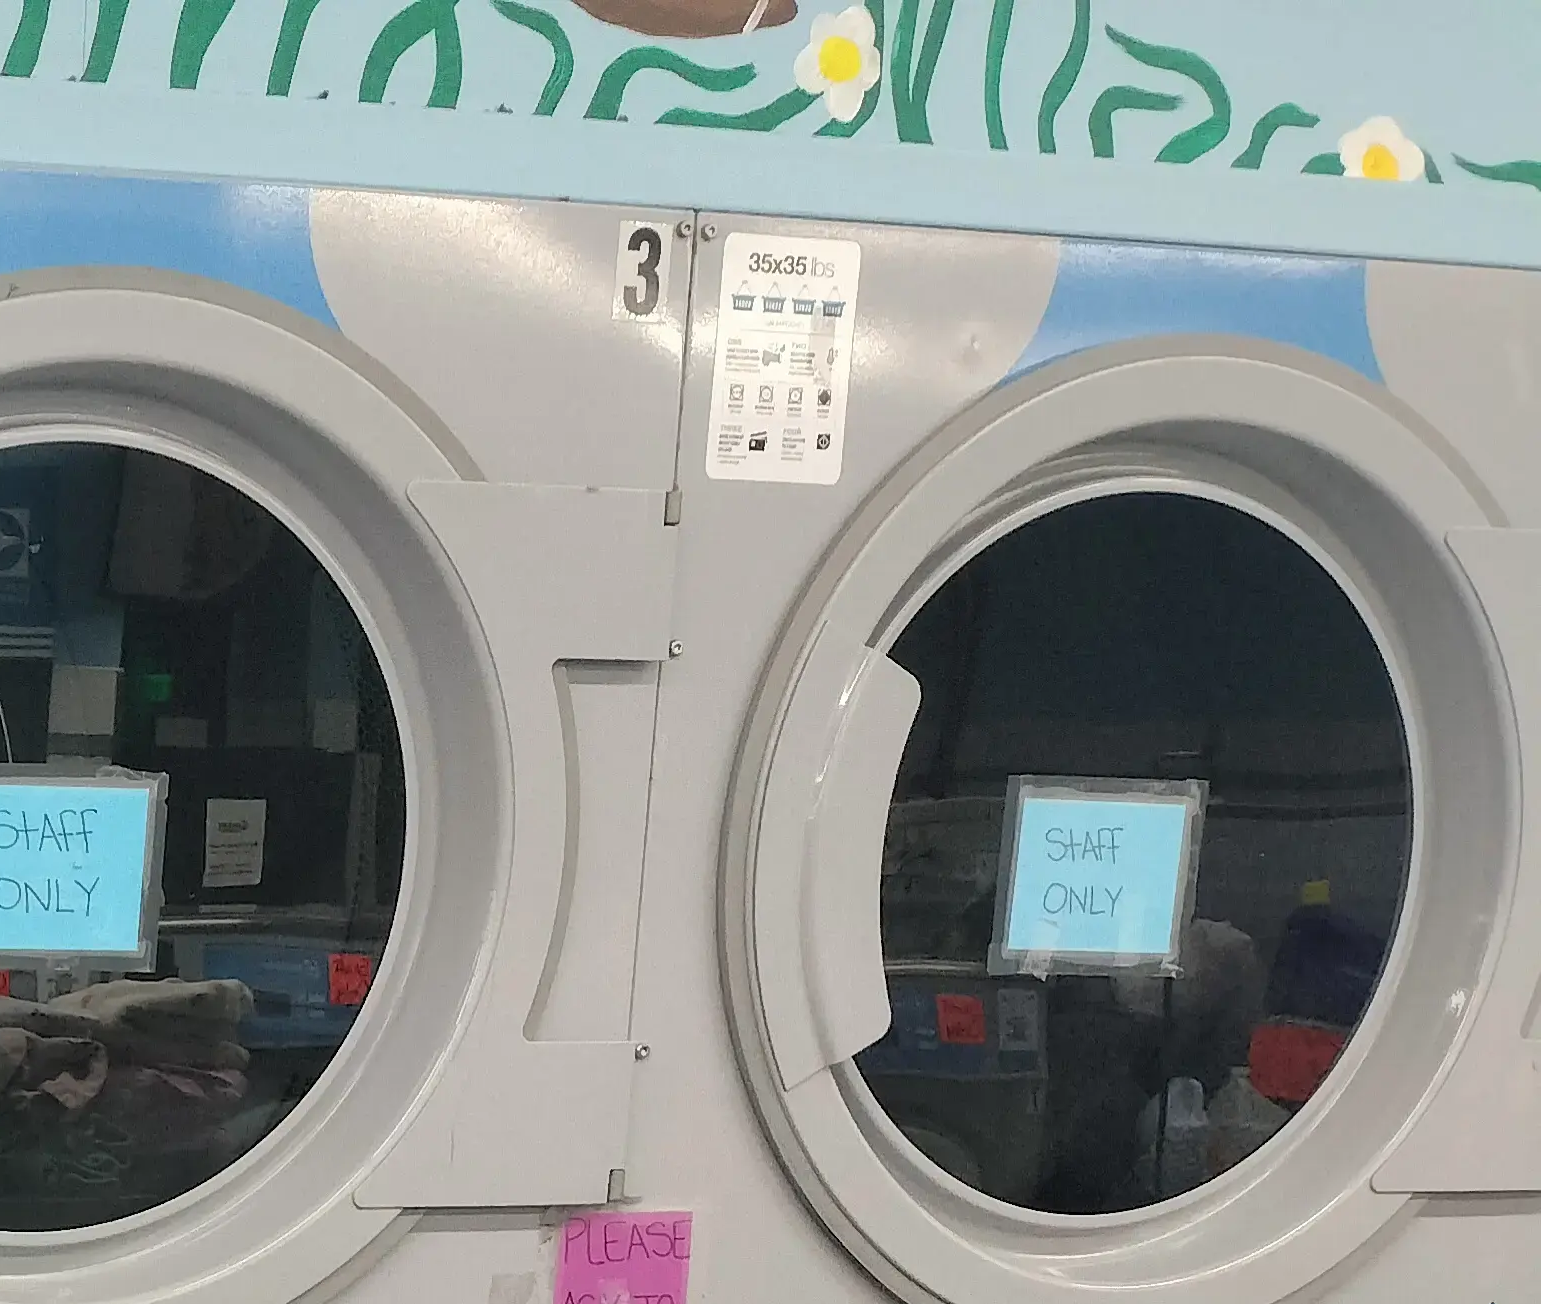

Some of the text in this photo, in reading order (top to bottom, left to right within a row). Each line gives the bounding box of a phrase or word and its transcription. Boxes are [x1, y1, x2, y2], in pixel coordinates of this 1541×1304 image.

[623, 227, 662, 316] 3
[749, 252, 835, 278] 35x35 lbs
[1043, 882, 1123, 917] ONLY
[564, 1218, 693, 1265] PLEASE
